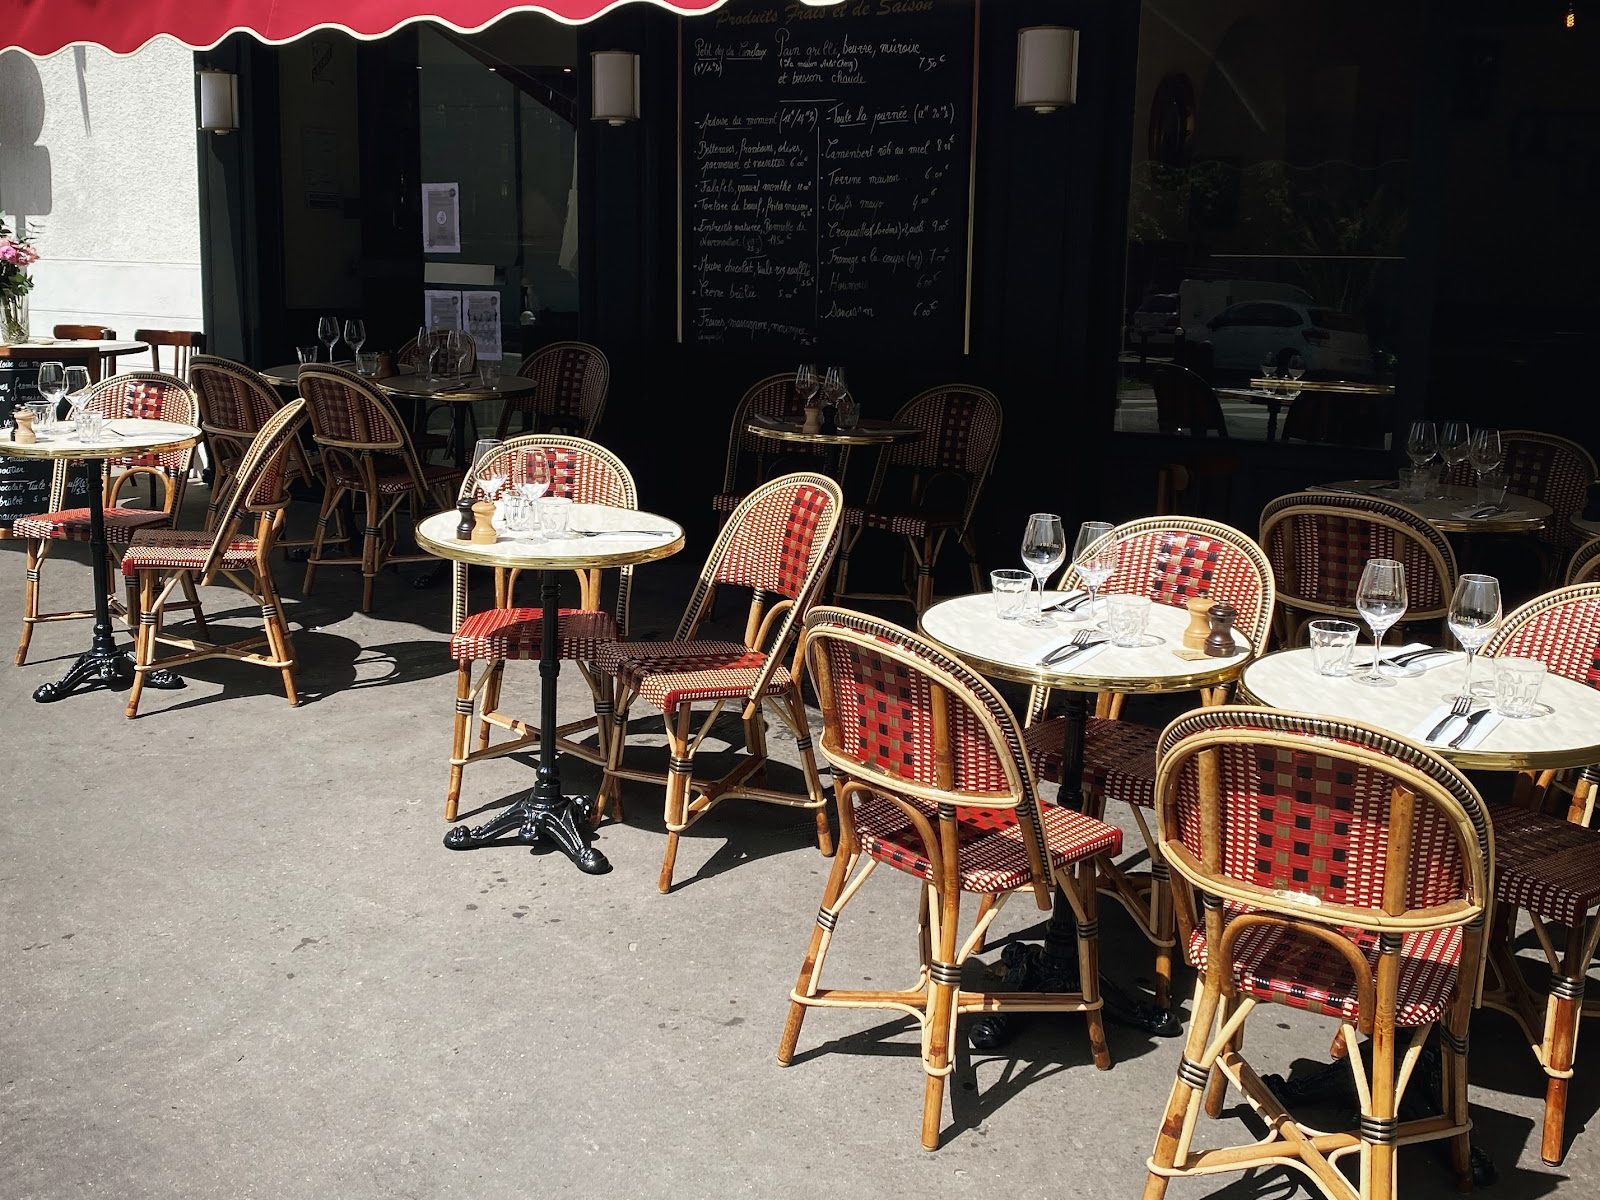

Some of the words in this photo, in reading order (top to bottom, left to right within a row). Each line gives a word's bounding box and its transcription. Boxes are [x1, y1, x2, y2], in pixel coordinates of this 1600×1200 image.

[717, 10, 777, 27] Produits
[832, 2, 847, 18] et
[852, 2, 870, 17] de
[877, 0, 933, 16] Saison
[775, 28, 800, 57] Pain
[778, 72, 787, 84] et
[832, 70, 866, 84] chaude
[746, 112, 777, 125] moment
[828, 102, 852, 123] Toute
[856, 105, 867, 121] la
[870, 105, 908, 135] journée
[825, 138, 873, 159] Camembert
[908, 140, 930, 155] miel
[828, 167, 862, 186] Terrine
[697, 198, 728, 211] Tartare
[731, 200, 739, 211] de
[827, 246, 859, 273] Fromage
[870, 247, 878, 262] la
